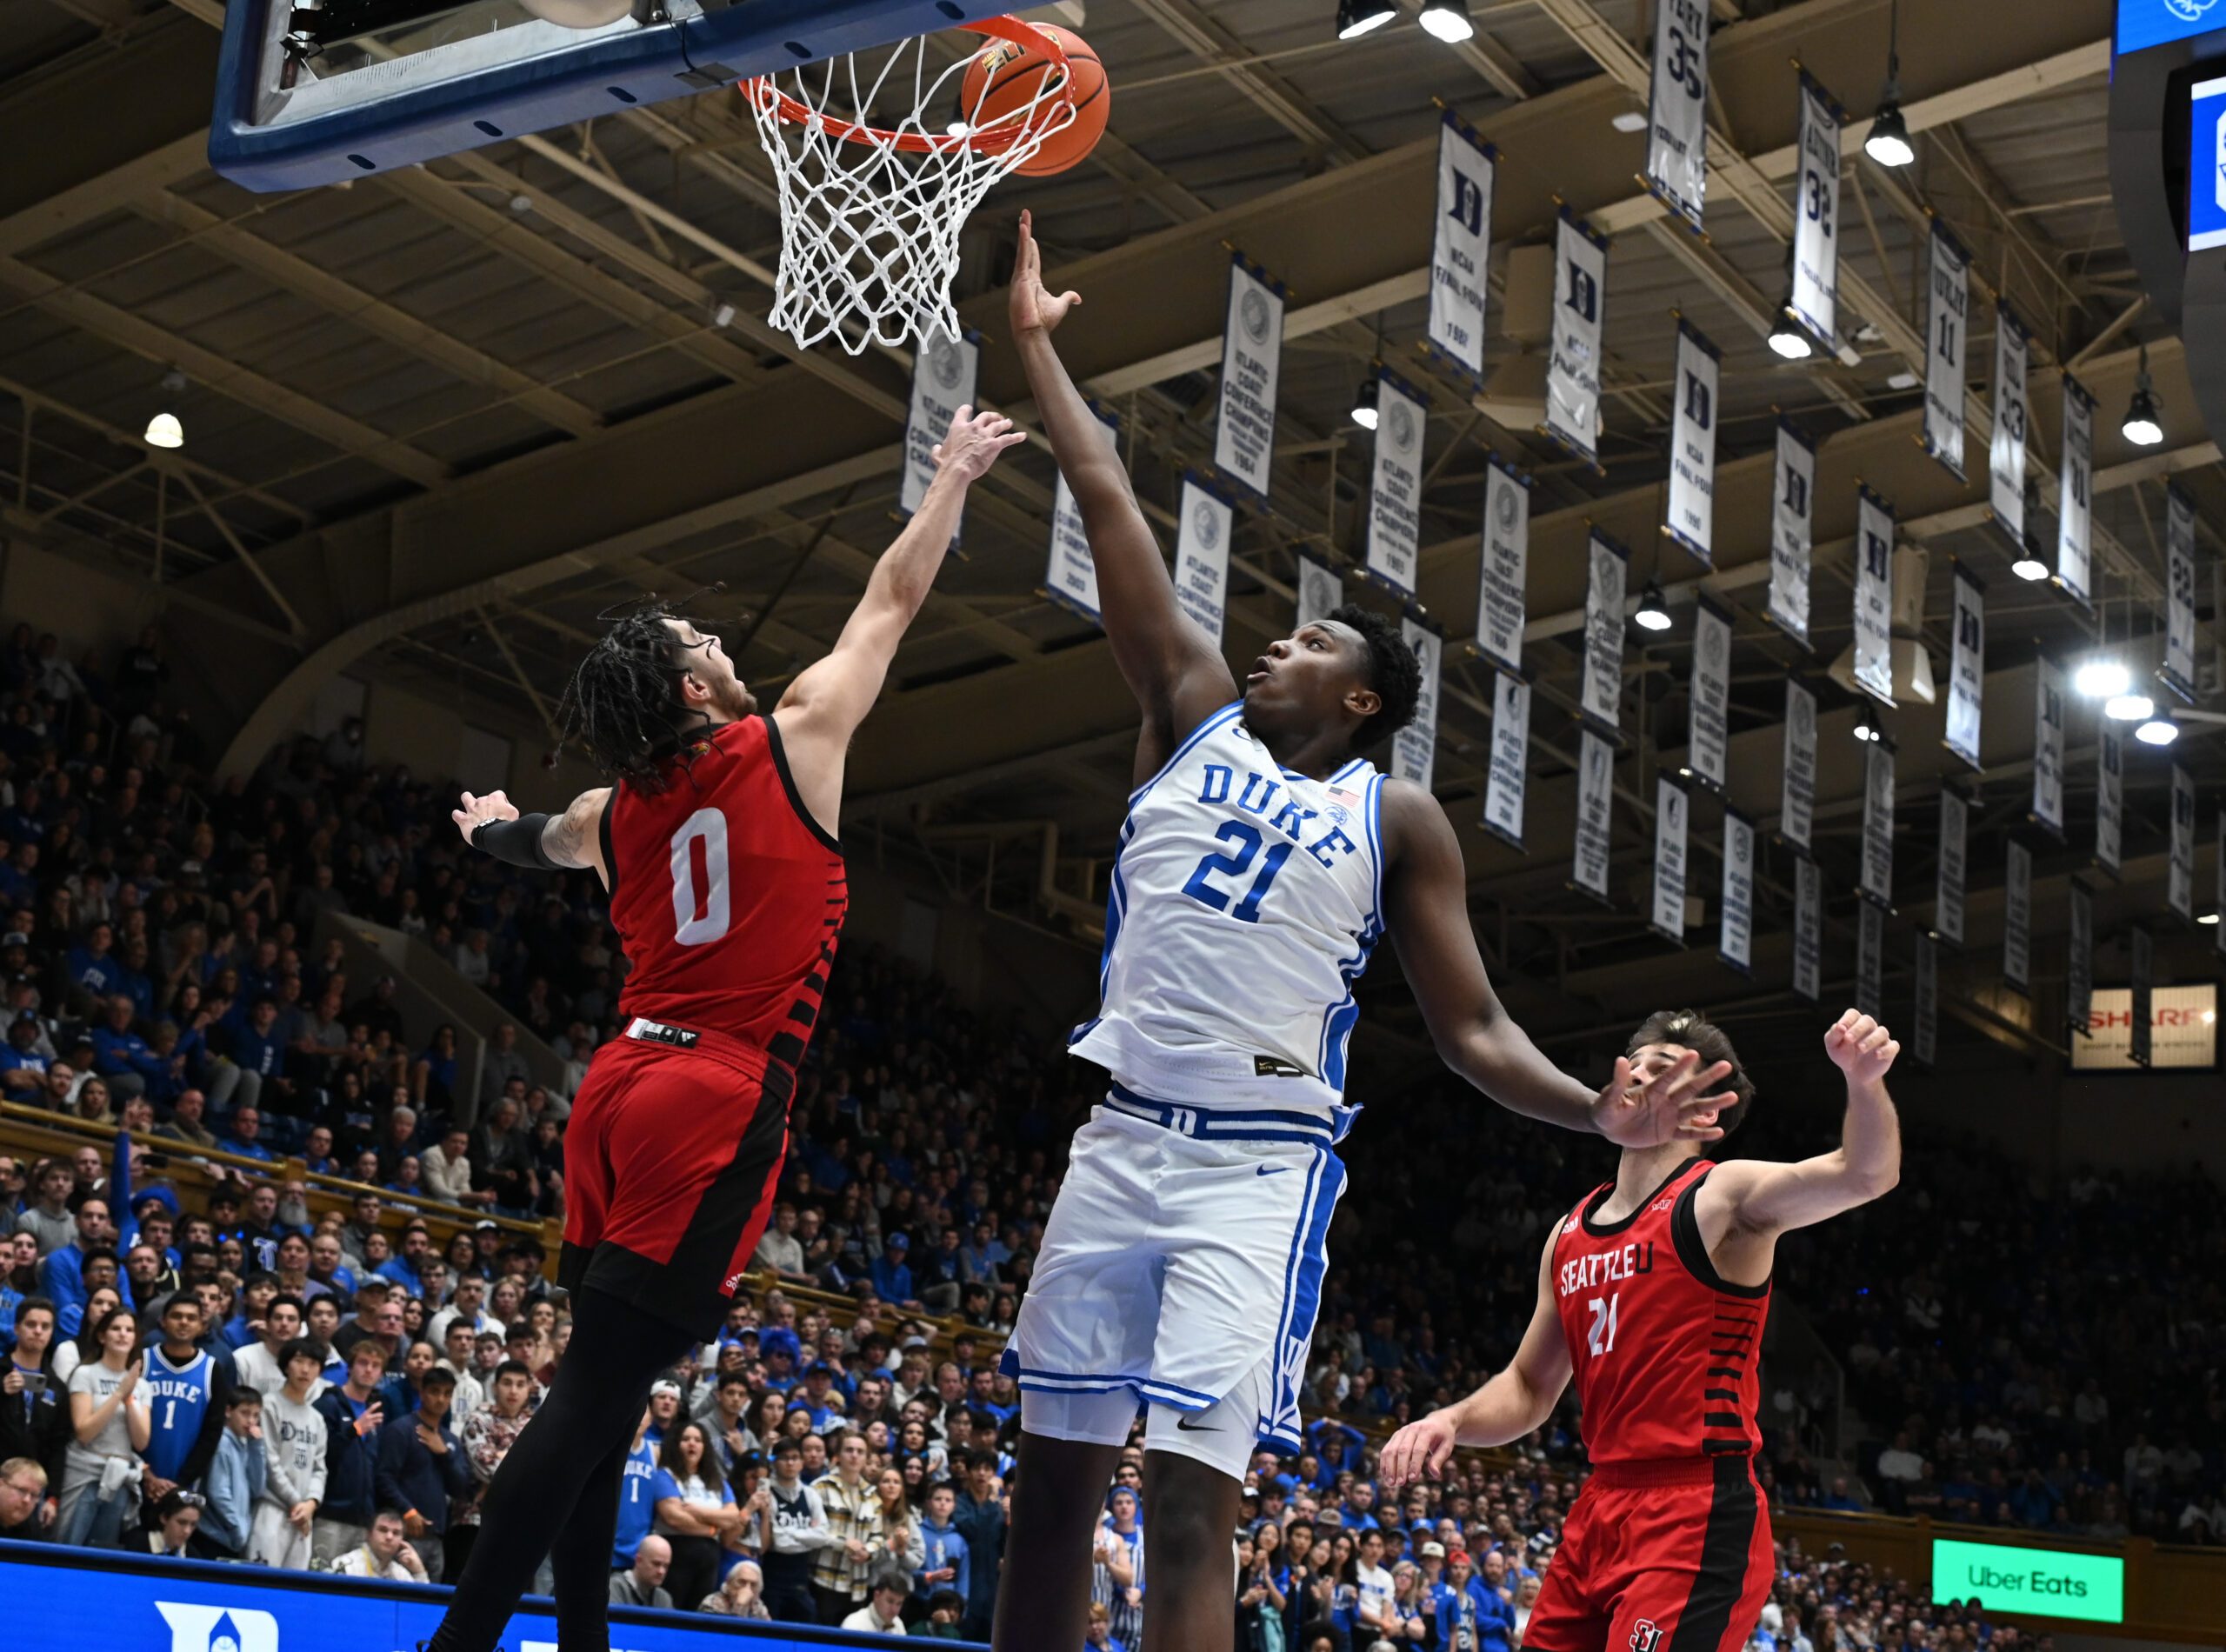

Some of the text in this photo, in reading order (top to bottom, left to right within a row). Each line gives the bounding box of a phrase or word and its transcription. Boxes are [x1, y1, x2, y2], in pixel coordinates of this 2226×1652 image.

[1668, 26, 1702, 100] 35
[1807, 170, 1831, 238] 32
[1451, 247, 1474, 275] NCAA
[1436, 265, 1462, 296] FINAL
[1938, 313, 1956, 368] 11
[1236, 349, 1269, 384] ATLANTIC
[1237, 370, 1263, 397] COAST
[1224, 381, 1274, 429] CONFERENCE
[1225, 401, 1270, 444] CHAMPIONS
[1686, 442, 1704, 465] NCAA
[1676, 458, 1694, 485] FINAL
[1197, 763, 1356, 869] DUKE
[670, 807, 731, 946] 0
[1181, 819, 1295, 924] 21
[1589, 1292, 1618, 1356] 21
[150, 1380, 202, 1403] DUKE
[163, 1400, 177, 1429] 1
[630, 1476, 639, 1503] 1
[1969, 1564, 2088, 1597] Uber Eats
